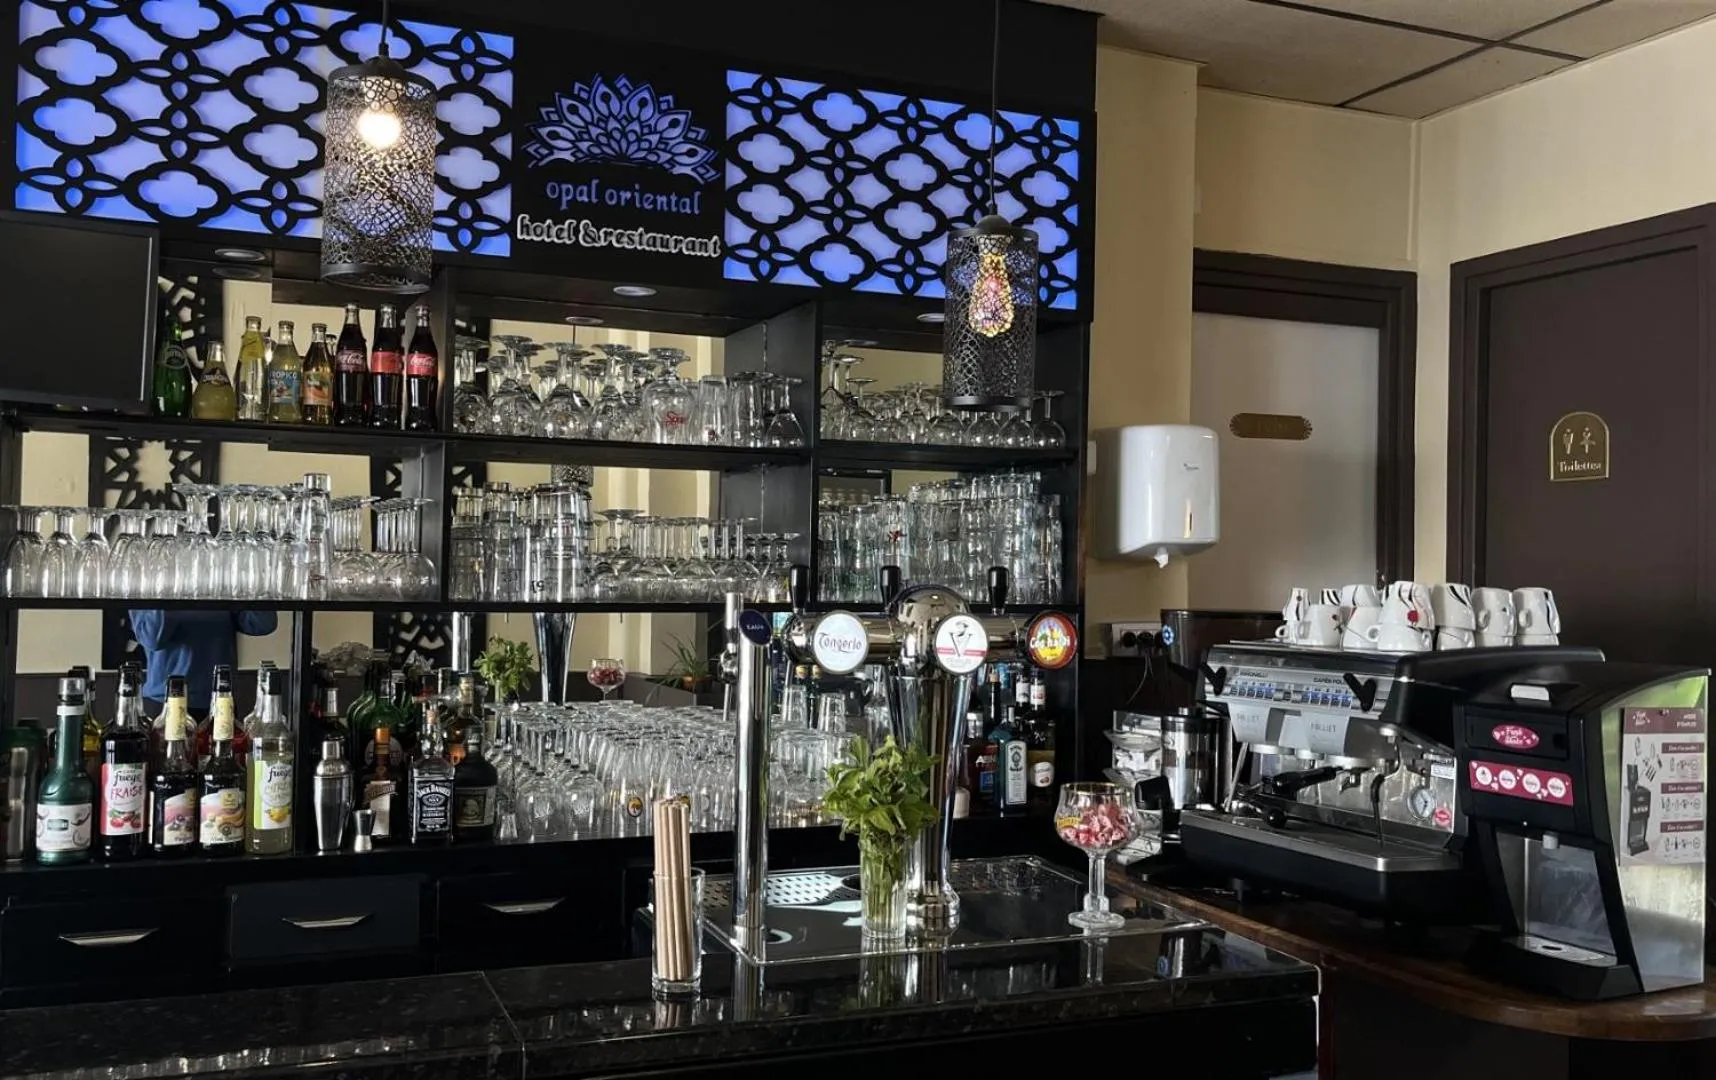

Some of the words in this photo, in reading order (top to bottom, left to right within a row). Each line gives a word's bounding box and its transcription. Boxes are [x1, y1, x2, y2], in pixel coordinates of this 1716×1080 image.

[546, 179, 599, 211] opal
[604, 184, 700, 215] oriental
[517, 213, 577, 244] hotel
[601, 227, 721, 257] restaurant
